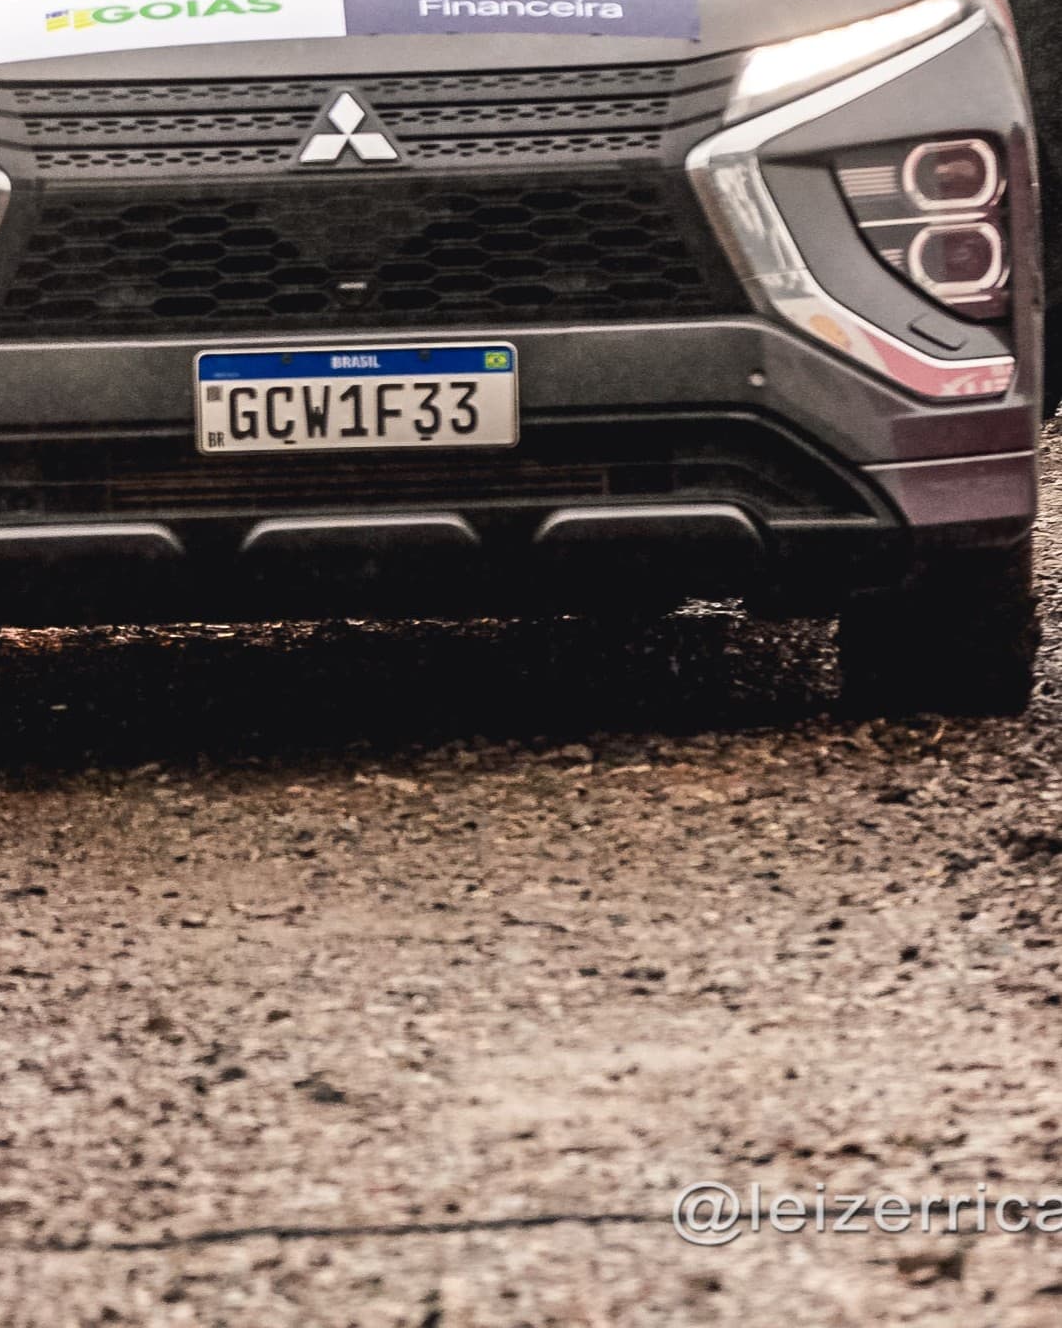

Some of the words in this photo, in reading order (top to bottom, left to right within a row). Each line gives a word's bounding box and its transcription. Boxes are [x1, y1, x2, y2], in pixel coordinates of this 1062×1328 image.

[330, 355, 381, 370] BRASIL
[229, 381, 479, 440] GCW1F33
[207, 432, 225, 449] BR
